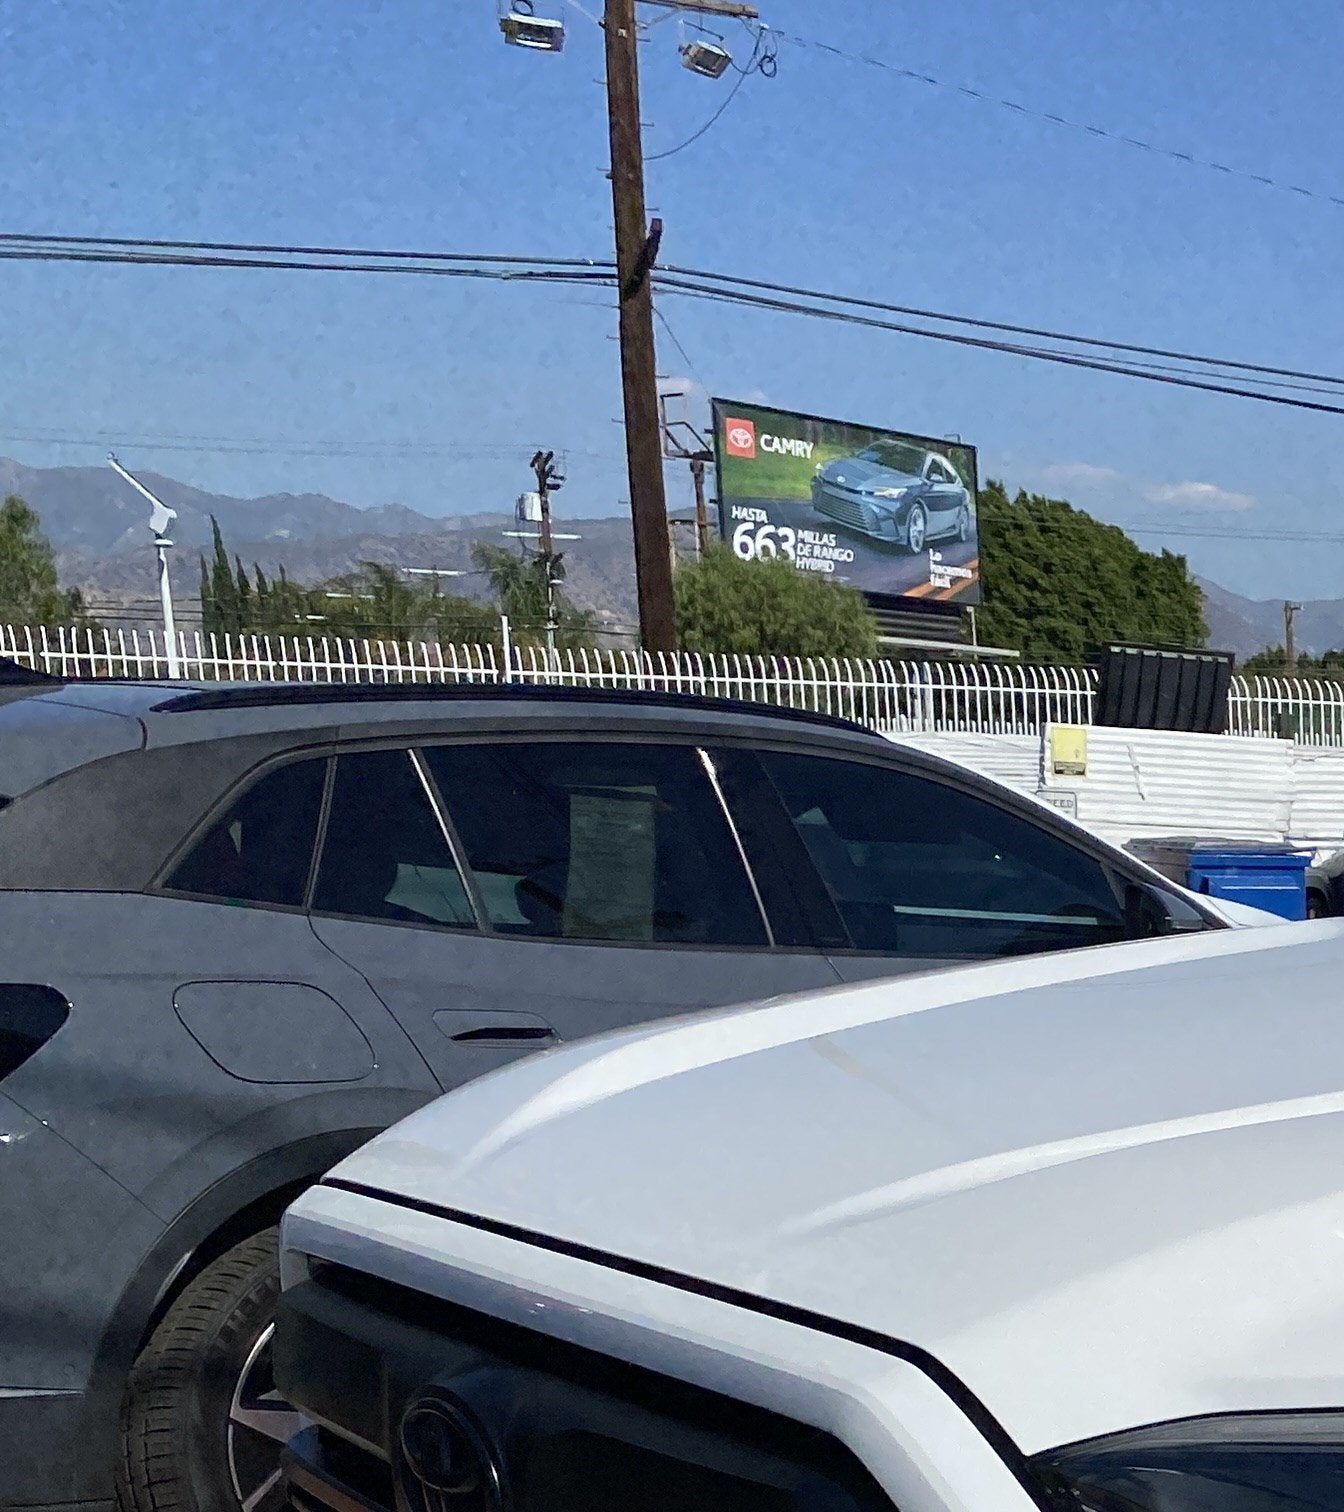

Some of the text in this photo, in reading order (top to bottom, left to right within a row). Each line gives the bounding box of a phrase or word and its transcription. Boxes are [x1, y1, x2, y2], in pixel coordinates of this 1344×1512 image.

[760, 434, 814, 459] CAMRY
[731, 505, 768, 523] HASTA
[733, 521, 796, 562] 663
[797, 529, 837, 547] MILLAS
[797, 542, 854, 563] DE RANGO
